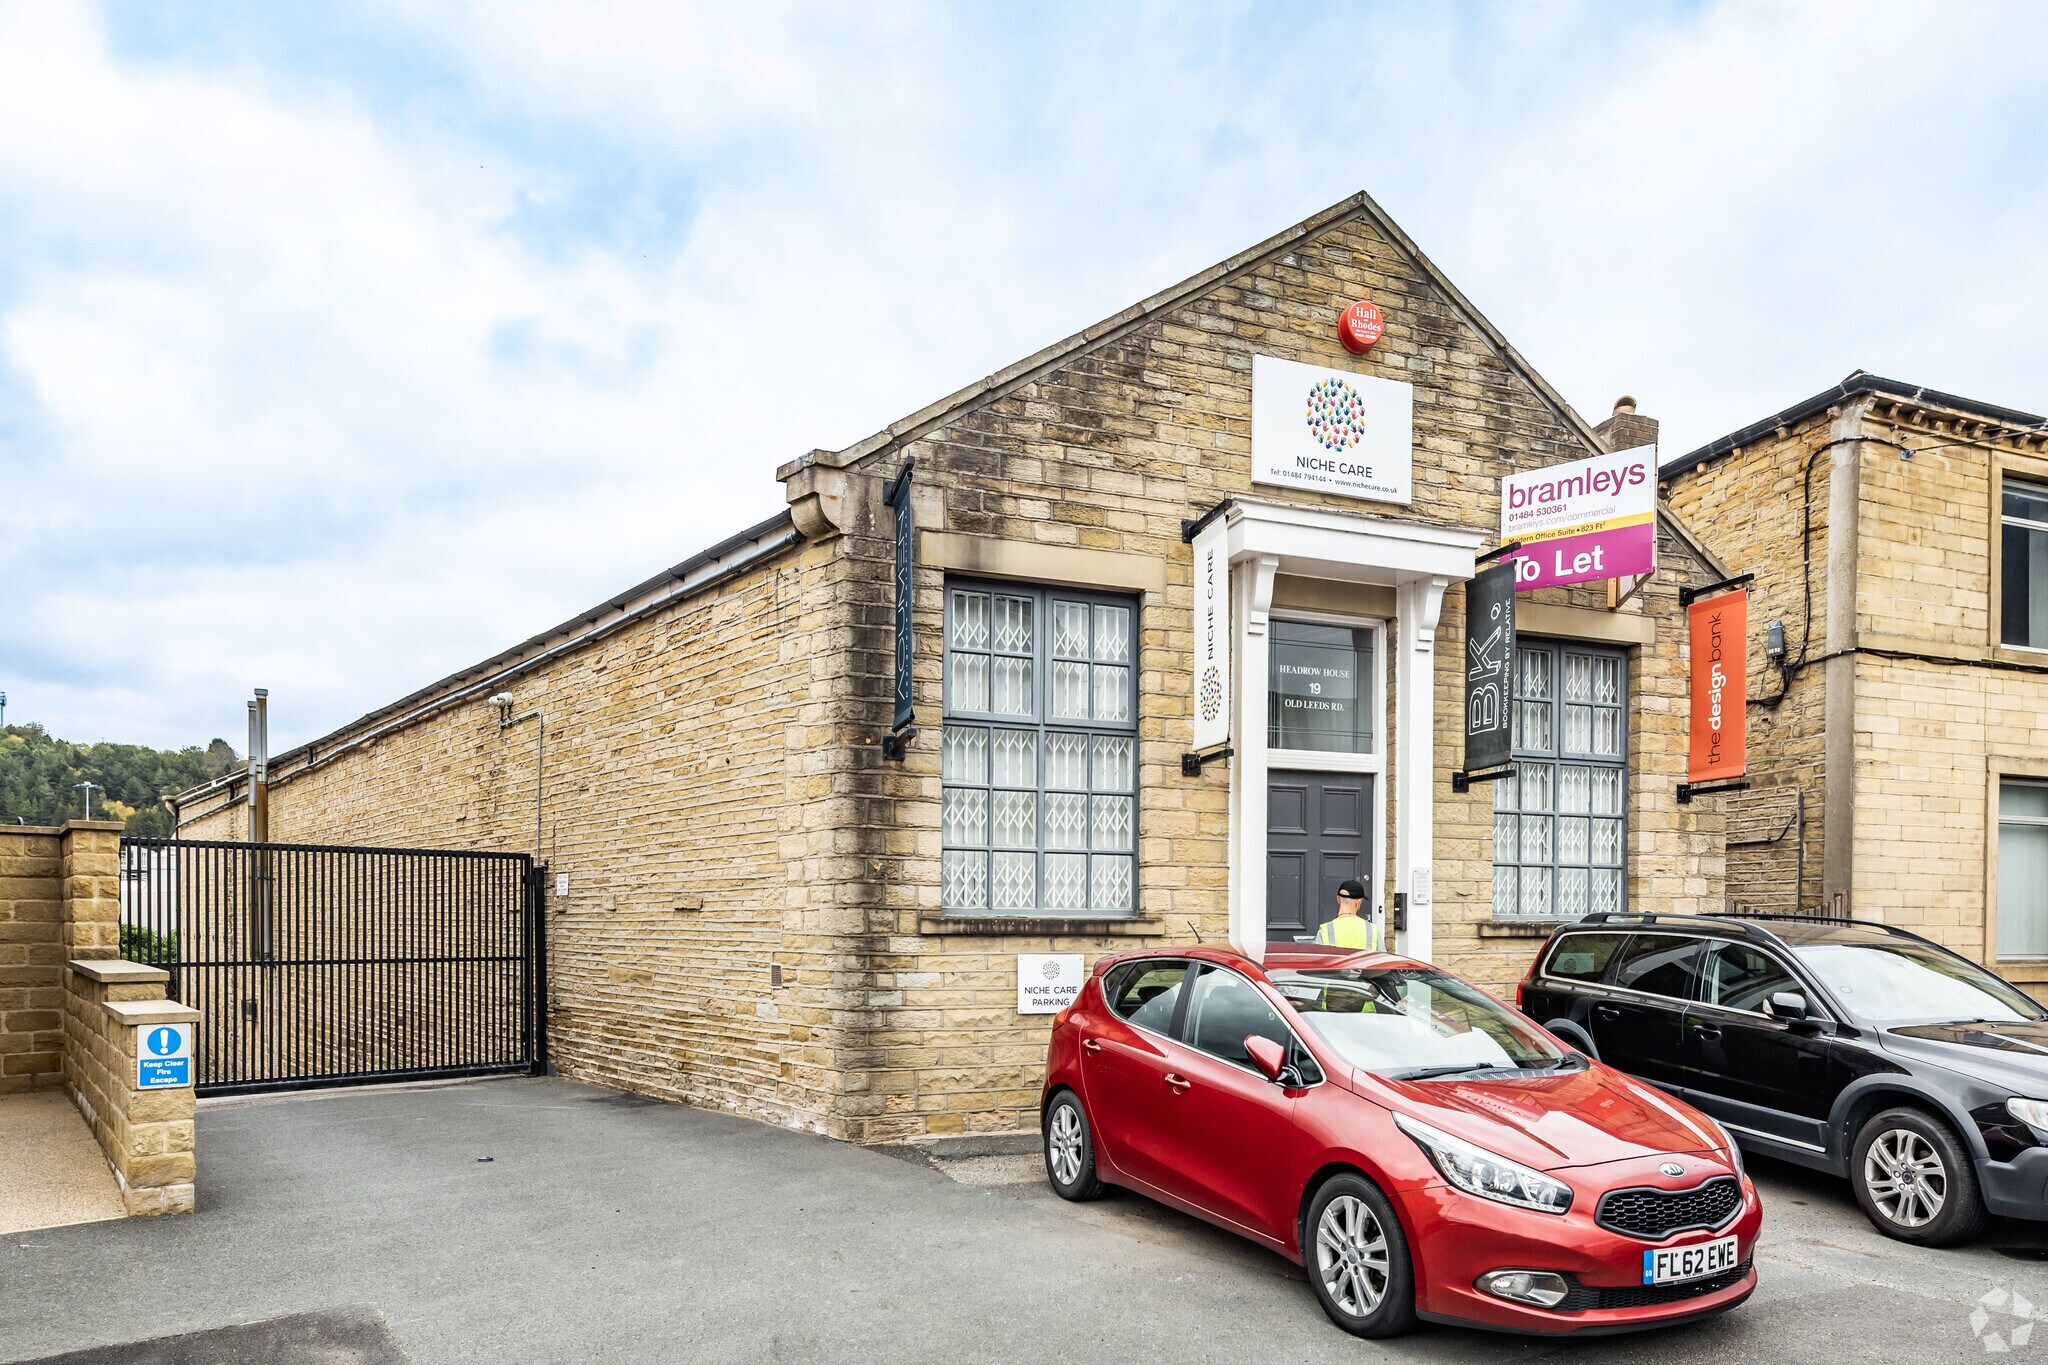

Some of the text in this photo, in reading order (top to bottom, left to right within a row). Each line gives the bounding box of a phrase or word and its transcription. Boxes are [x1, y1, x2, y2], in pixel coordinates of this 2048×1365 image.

[1355, 306, 1376, 320] Hall
[1296, 455, 1373, 479] NICHE CARE
[1270, 468, 1398, 494] Tel: 01484 794144 www.nichecare.co.uk
[1508, 463, 1646, 510] bramleys
[1508, 504, 1567, 522] 01484 530361
[1508, 505, 1616, 533] bramleys.com/commercial
[1535, 532, 1556, 541] Office
[1557, 528, 1576, 537] Suite
[1581, 524, 1594, 533] 823
[1510, 544, 1604, 583] To Let
[1504, 646, 1510, 660] BY
[1279, 664, 1351, 679] HEADROW HOUSE
[1308, 682, 1322, 695] 19
[1502, 661, 1510, 729] BOOKKEEPING
[1284, 698, 1345, 712] OLD LEEDS RD.
[1024, 986, 1078, 995] NICHE CARE
[1032, 998, 1070, 1006] PARKING
[143, 1061, 163, 1069] Keep
[150, 1076, 178, 1084] Escape
[1657, 1248, 1704, 1279] FL62
[1708, 1241, 1735, 1271] EWE
